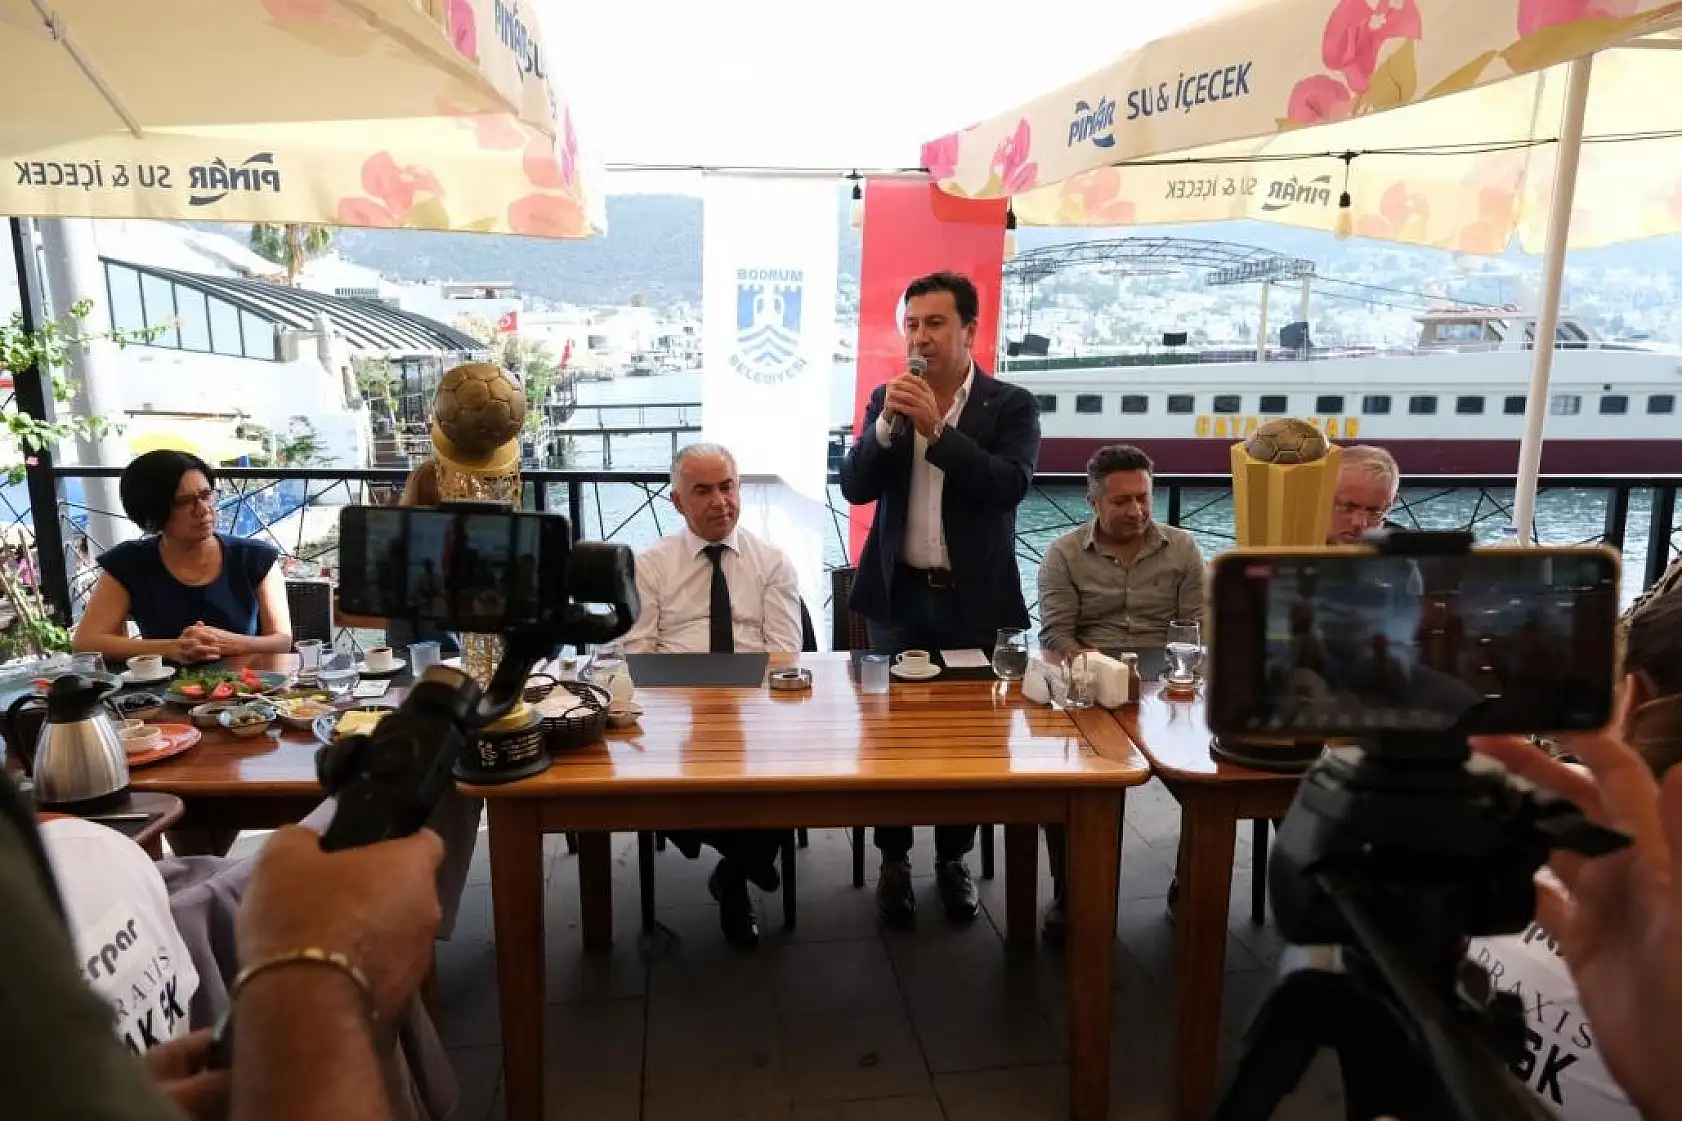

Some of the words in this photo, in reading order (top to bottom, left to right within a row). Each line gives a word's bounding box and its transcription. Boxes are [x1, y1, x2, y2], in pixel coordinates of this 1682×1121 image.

[1126, 88, 1152, 120] SU
[1156, 81, 1169, 112] &
[1174, 61, 1252, 114] İÇECEK
[736, 267, 803, 282] BODRUM
